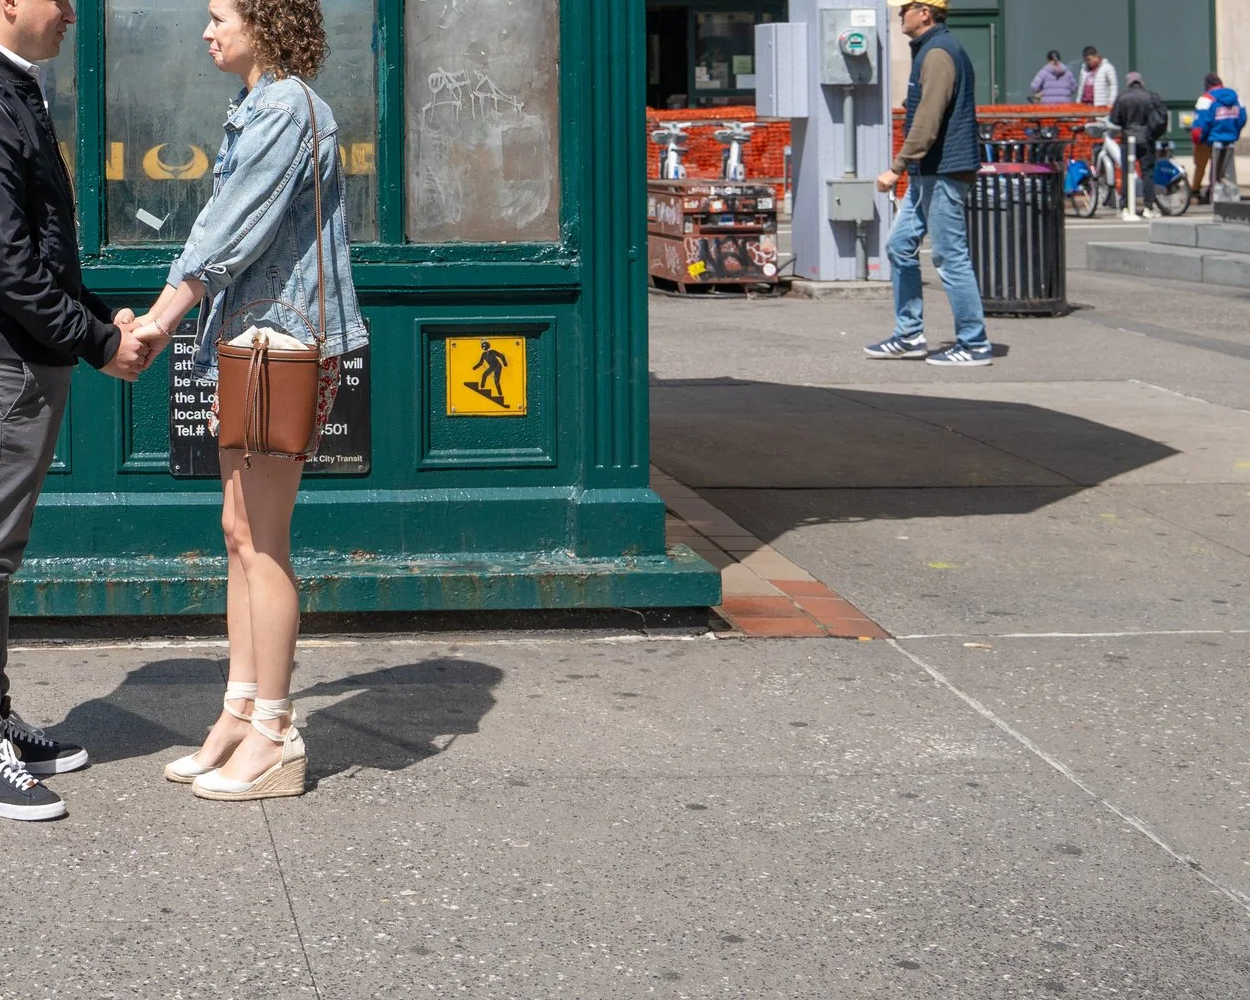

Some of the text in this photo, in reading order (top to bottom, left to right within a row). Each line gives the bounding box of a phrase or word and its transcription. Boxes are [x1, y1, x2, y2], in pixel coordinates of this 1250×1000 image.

[343, 357, 363, 369] will
[174, 375, 191, 387] be
[346, 374, 360, 386] to
[174, 392, 195, 404] the
[174, 408, 215, 420] locate
[175, 424, 205, 437] Tel.#
[319, 454, 335, 464] City
[336, 454, 363, 463] Transit
